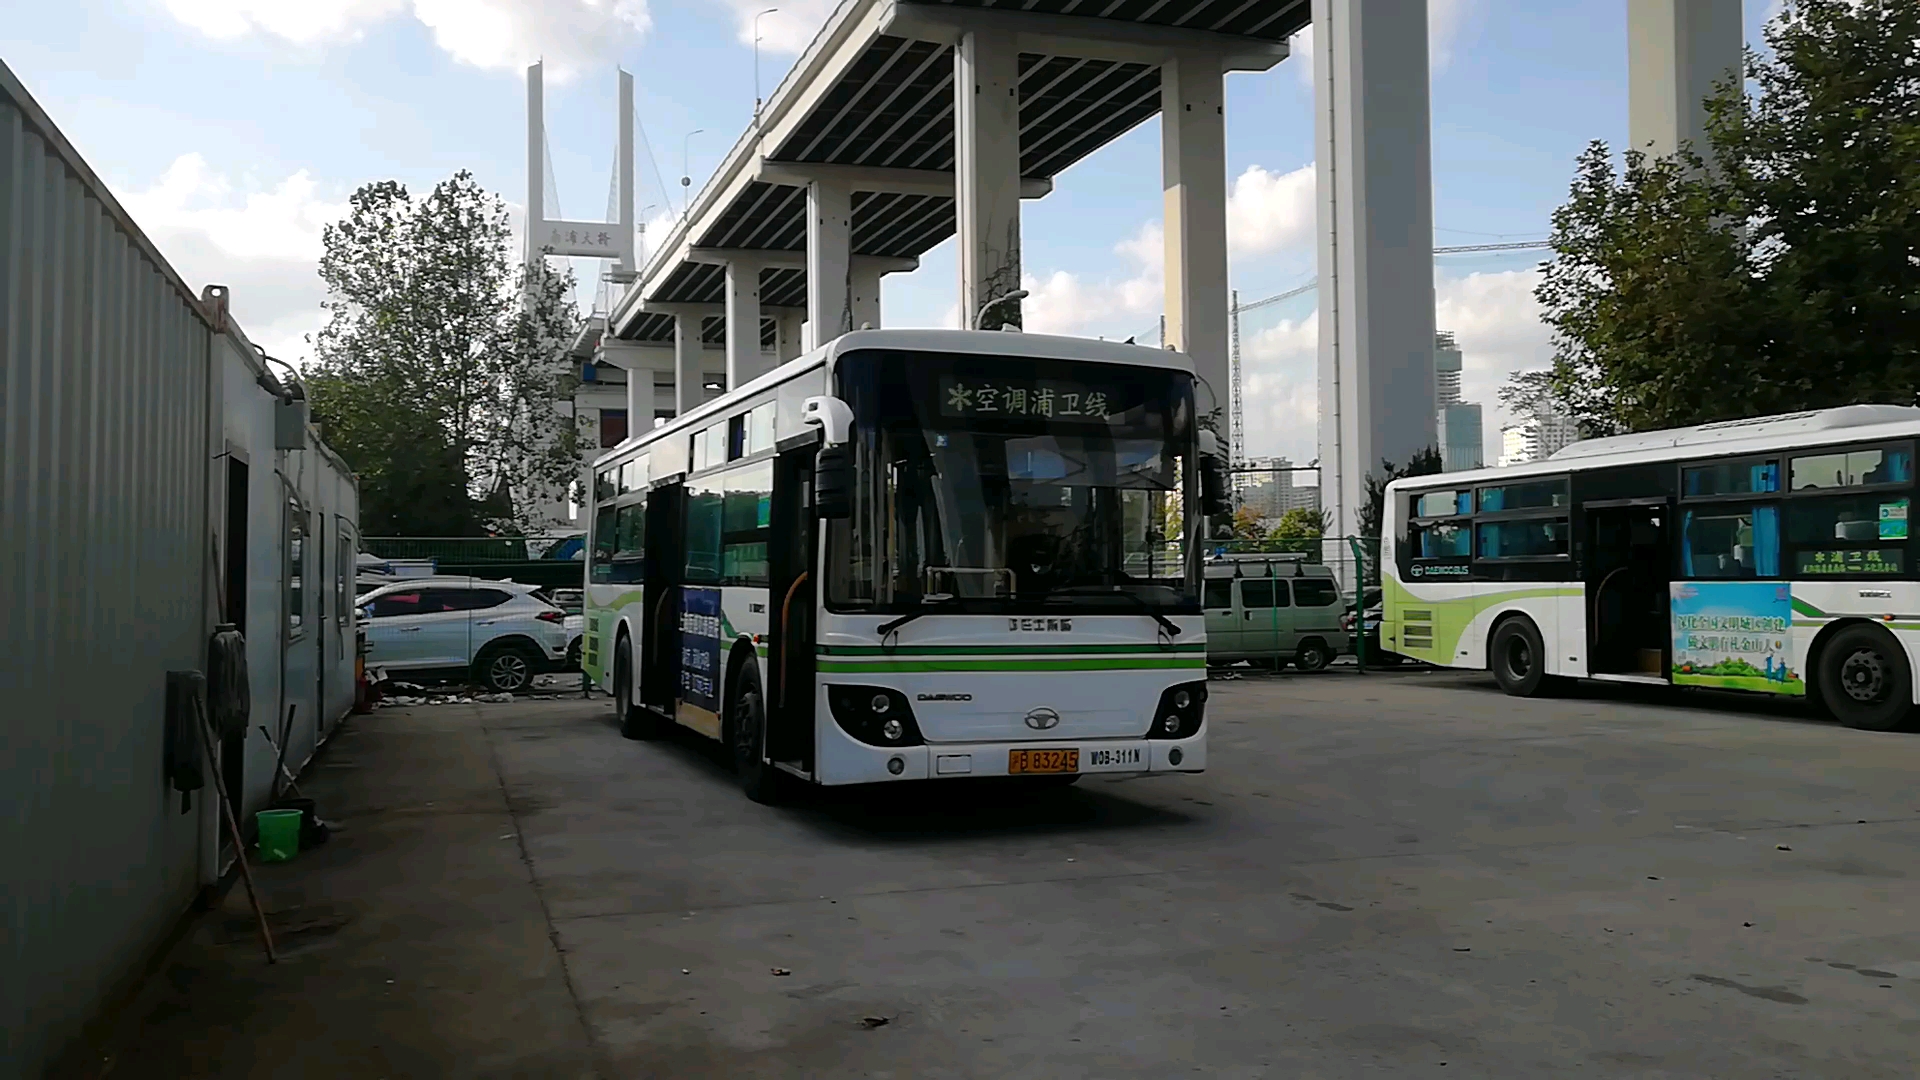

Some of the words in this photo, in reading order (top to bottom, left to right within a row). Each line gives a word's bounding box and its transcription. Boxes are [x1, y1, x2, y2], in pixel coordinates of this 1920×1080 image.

[976, 384, 1110, 421] 空调浦卫线
